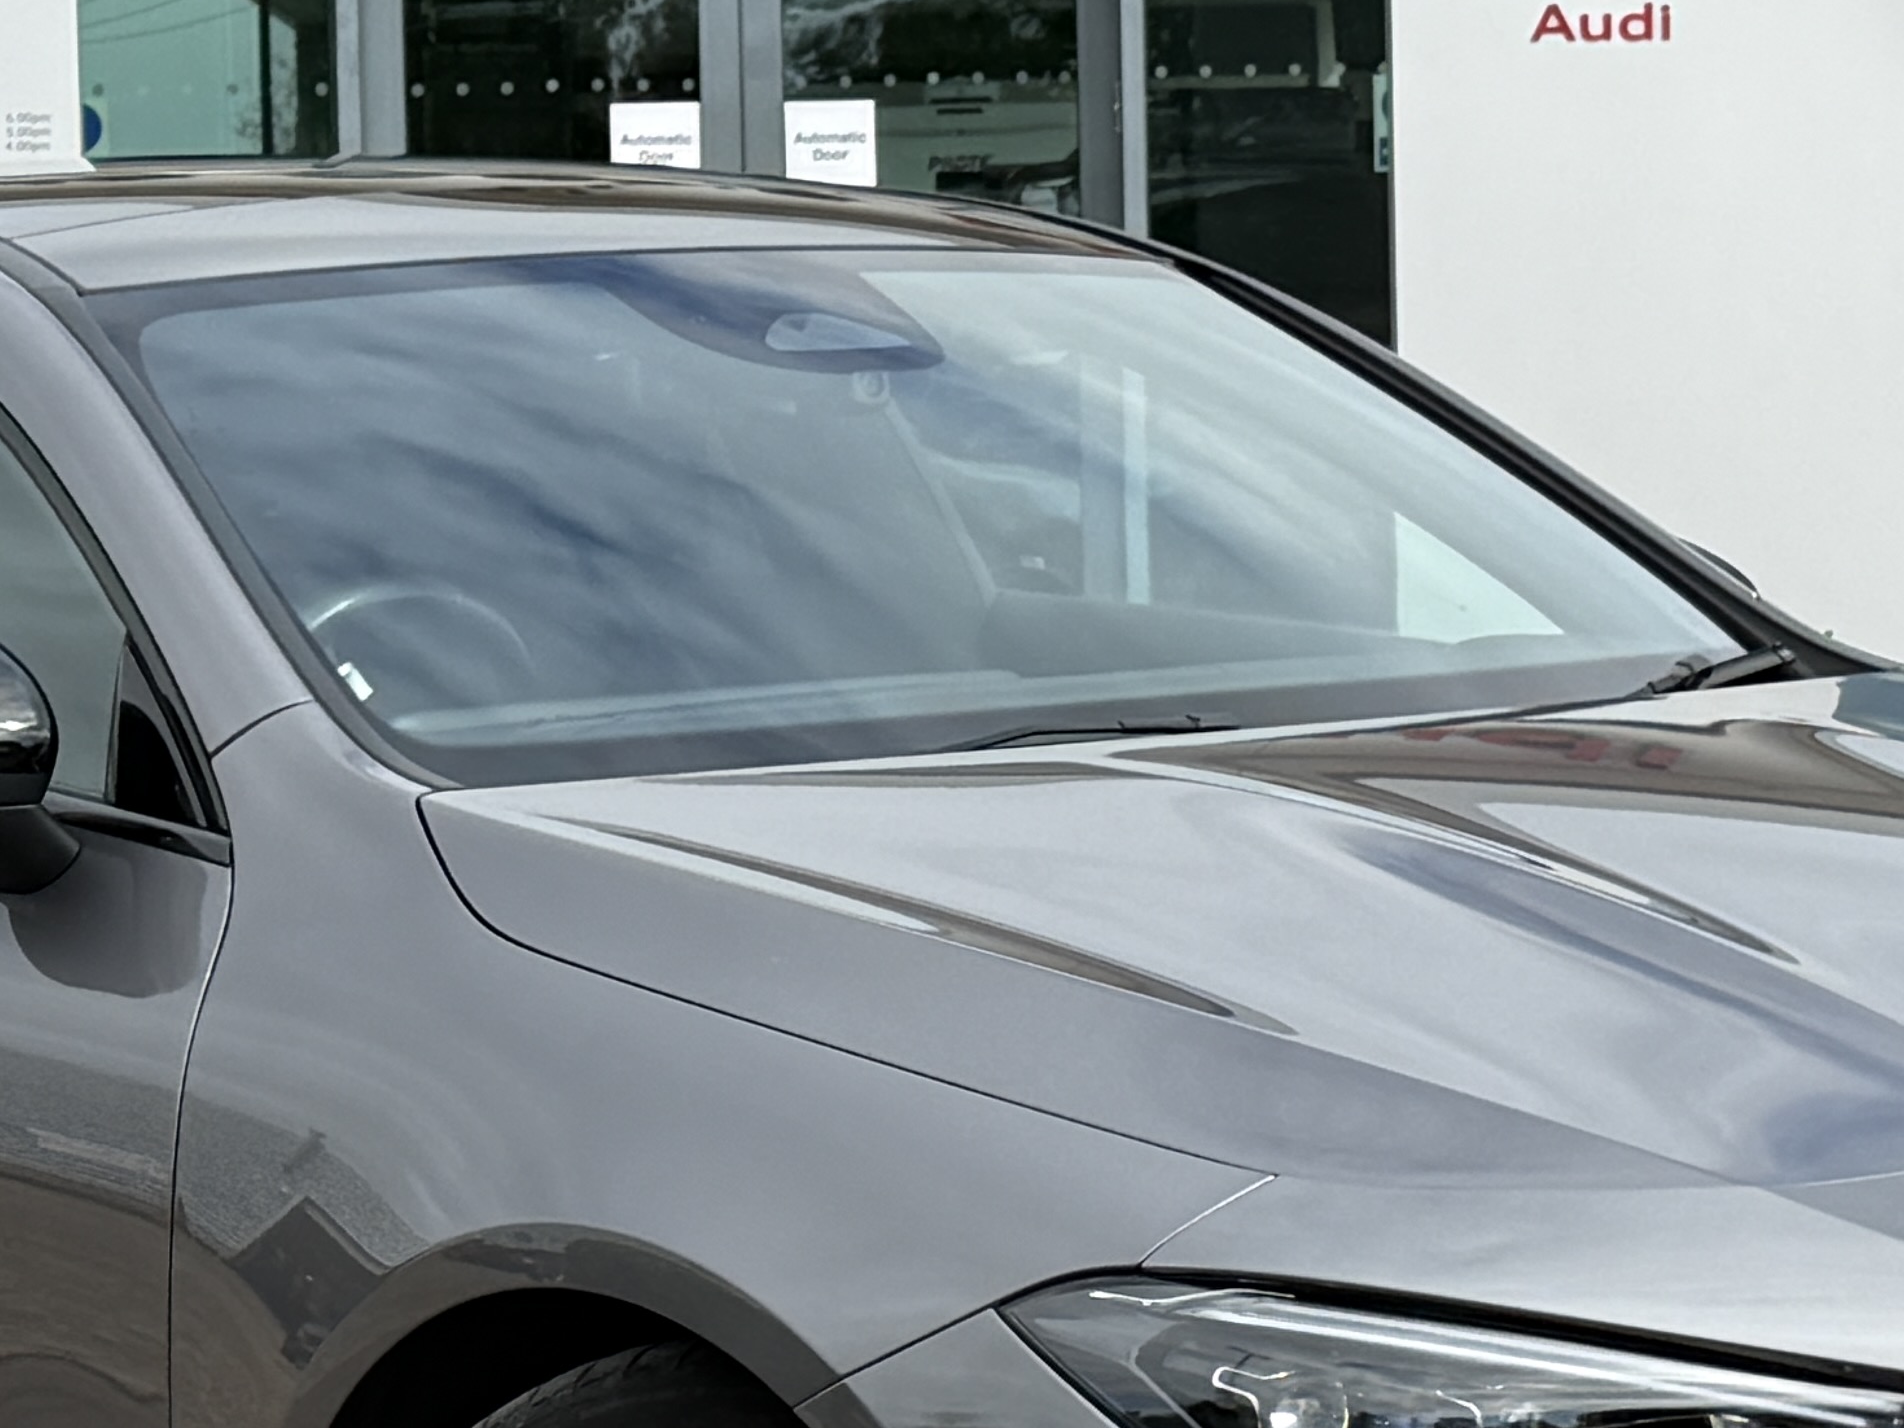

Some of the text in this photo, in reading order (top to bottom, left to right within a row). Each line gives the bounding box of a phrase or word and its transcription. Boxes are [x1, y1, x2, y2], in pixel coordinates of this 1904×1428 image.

[1530, 2, 1672, 44] Audi
[620, 133, 692, 146] Automatic
[794, 131, 867, 145] Automatic
[812, 148, 850, 162] Door
